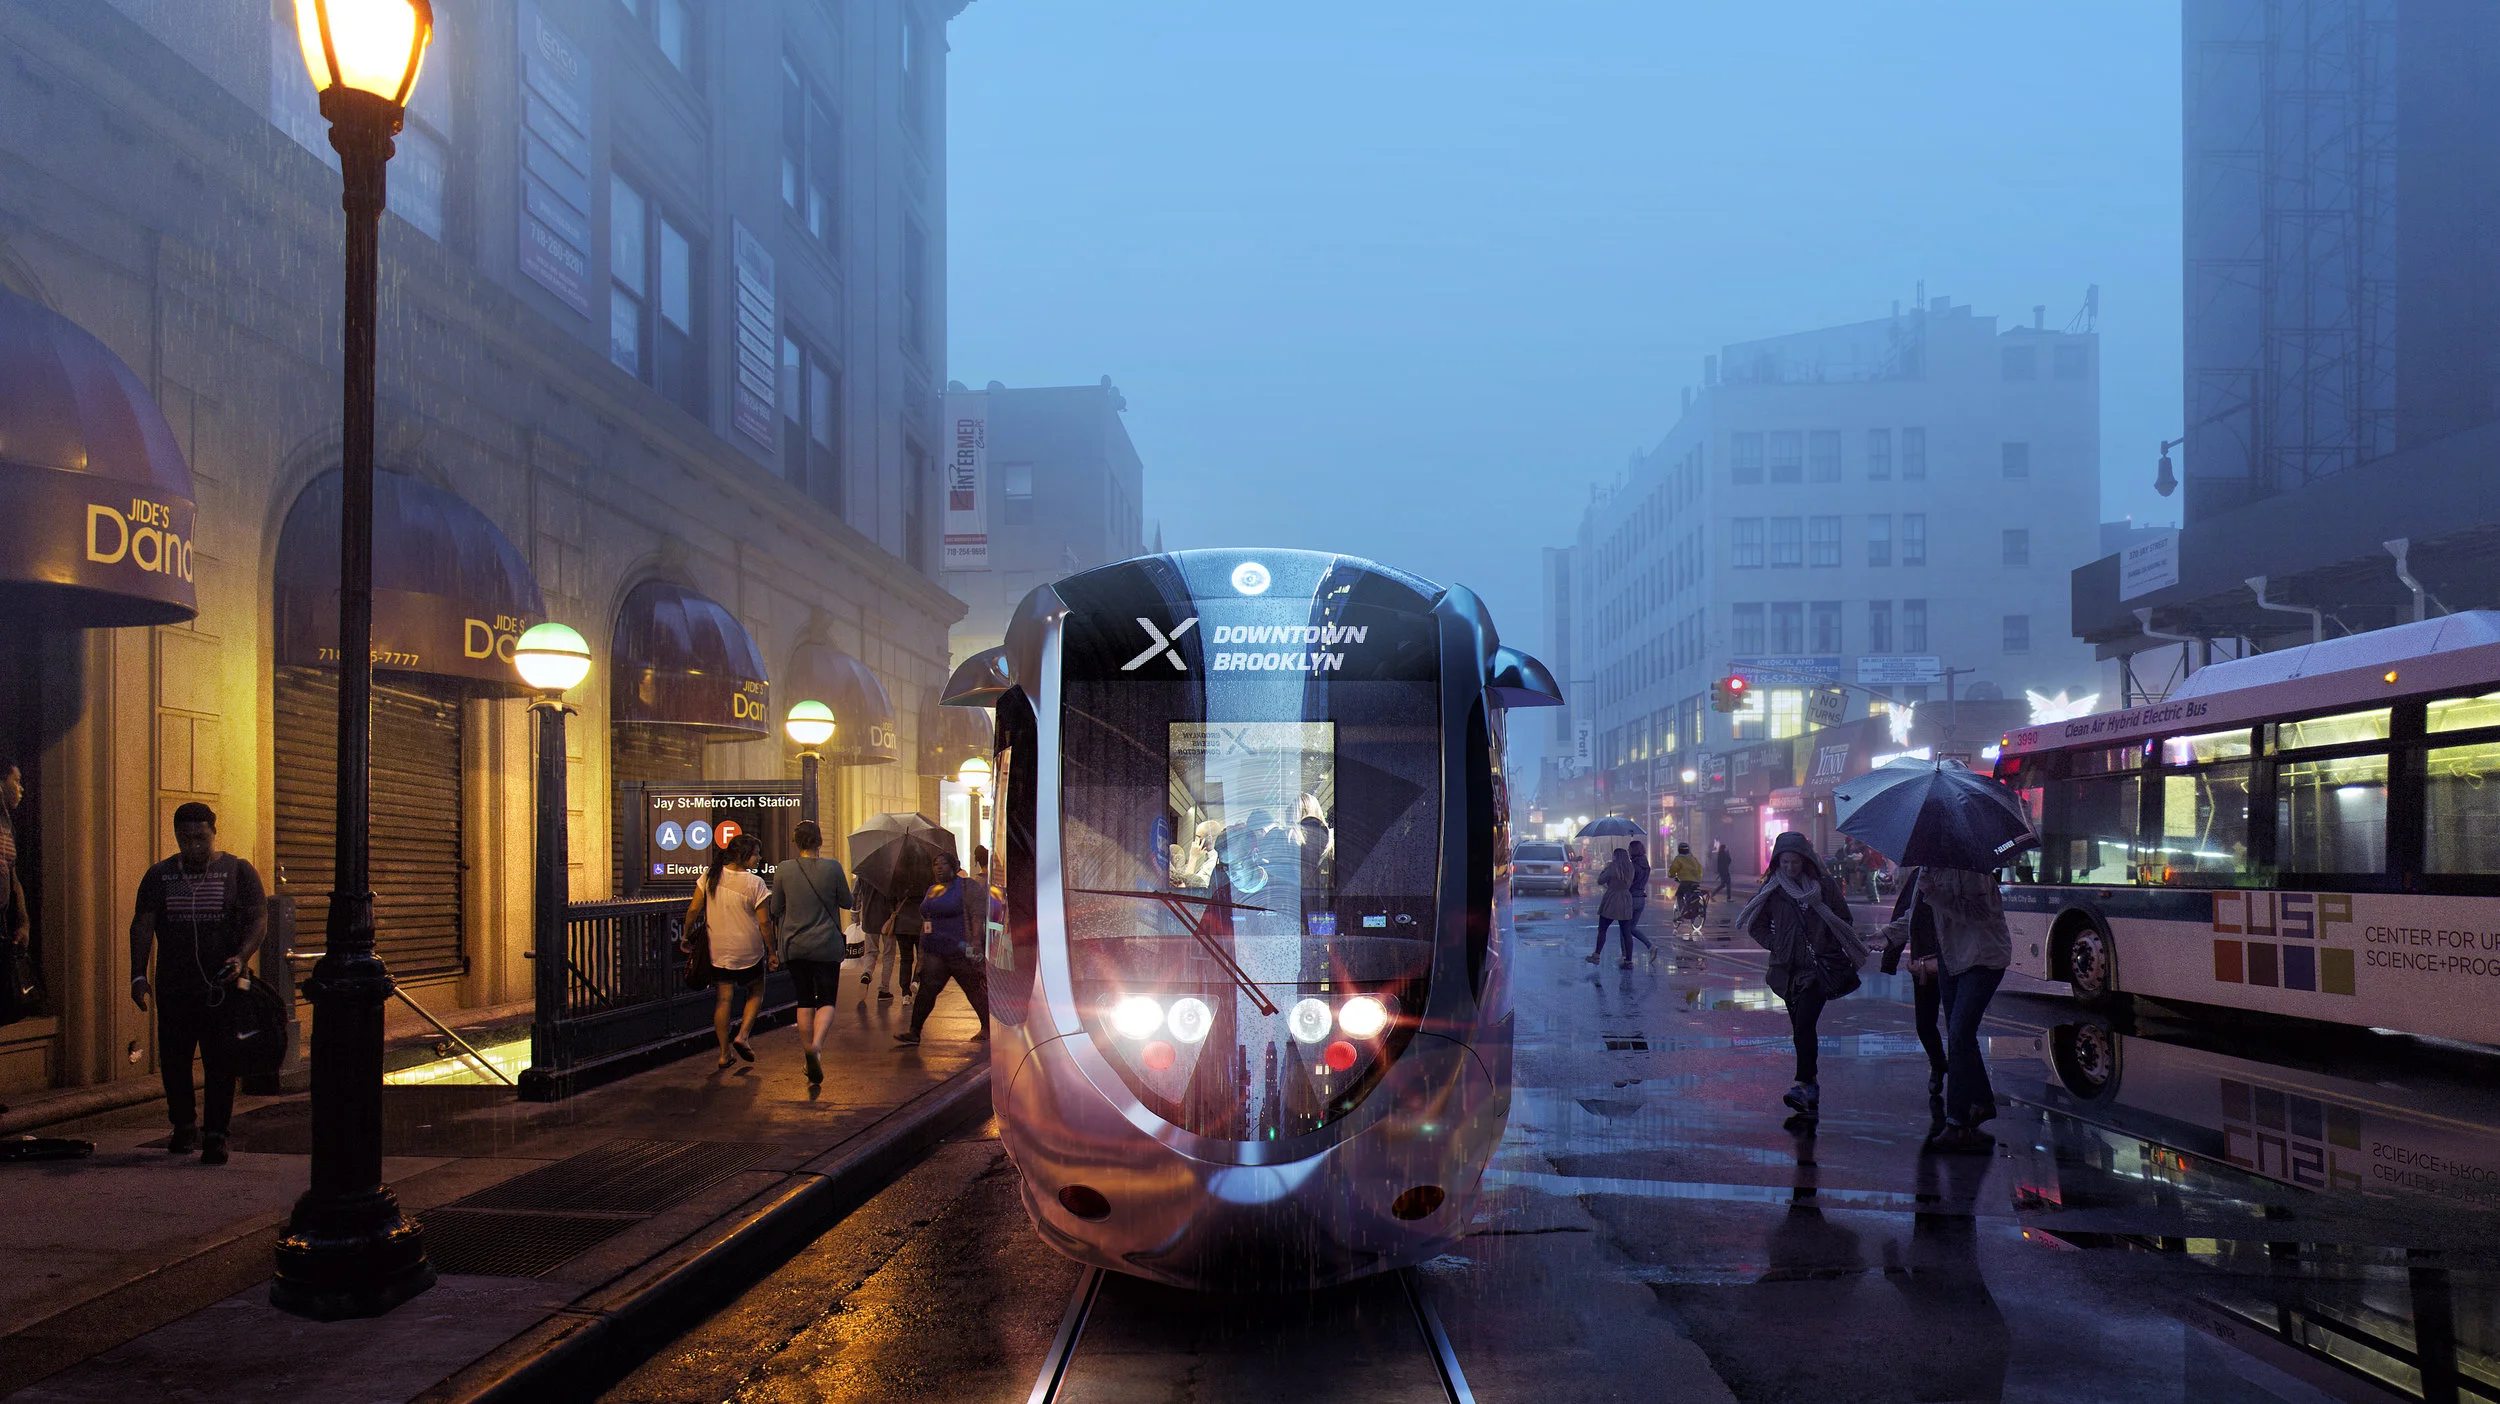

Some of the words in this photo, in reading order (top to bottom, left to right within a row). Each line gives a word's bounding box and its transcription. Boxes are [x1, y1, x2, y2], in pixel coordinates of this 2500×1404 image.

[127, 498, 170, 529] JIDE'S
[1212, 625, 1368, 645] DOWNTOWN
[1212, 652, 1345, 671] BROOKLYN
[1819, 695, 1839, 709] NO
[1810, 706, 1841, 724] TURNS
[2065, 720, 2089, 738] Clean
[2090, 718, 2106, 735] Air
[2107, 711, 2141, 733] Hybrid
[2142, 705, 2185, 725] Electric
[2186, 700, 2208, 718] Bus
[1578, 729, 1588, 758] Pratt
[2017, 731, 2039, 747] 3990
[653, 797, 675, 811] Jay
[677, 796, 755, 809] St-MetroTech
[758, 796, 801, 808] Station
[661, 827, 678, 845] A
[691, 826, 706, 845] C
[722, 826, 735, 844] F
[666, 863, 710, 875] Elevato
[761, 862, 778, 875] Ja
[2212, 890, 2353, 939] CUSP
[2365, 926, 2433, 947] CENTER
[2437, 930, 2475, 950] FOR
[2366, 950, 2500, 977] SCIENCE+PROG
